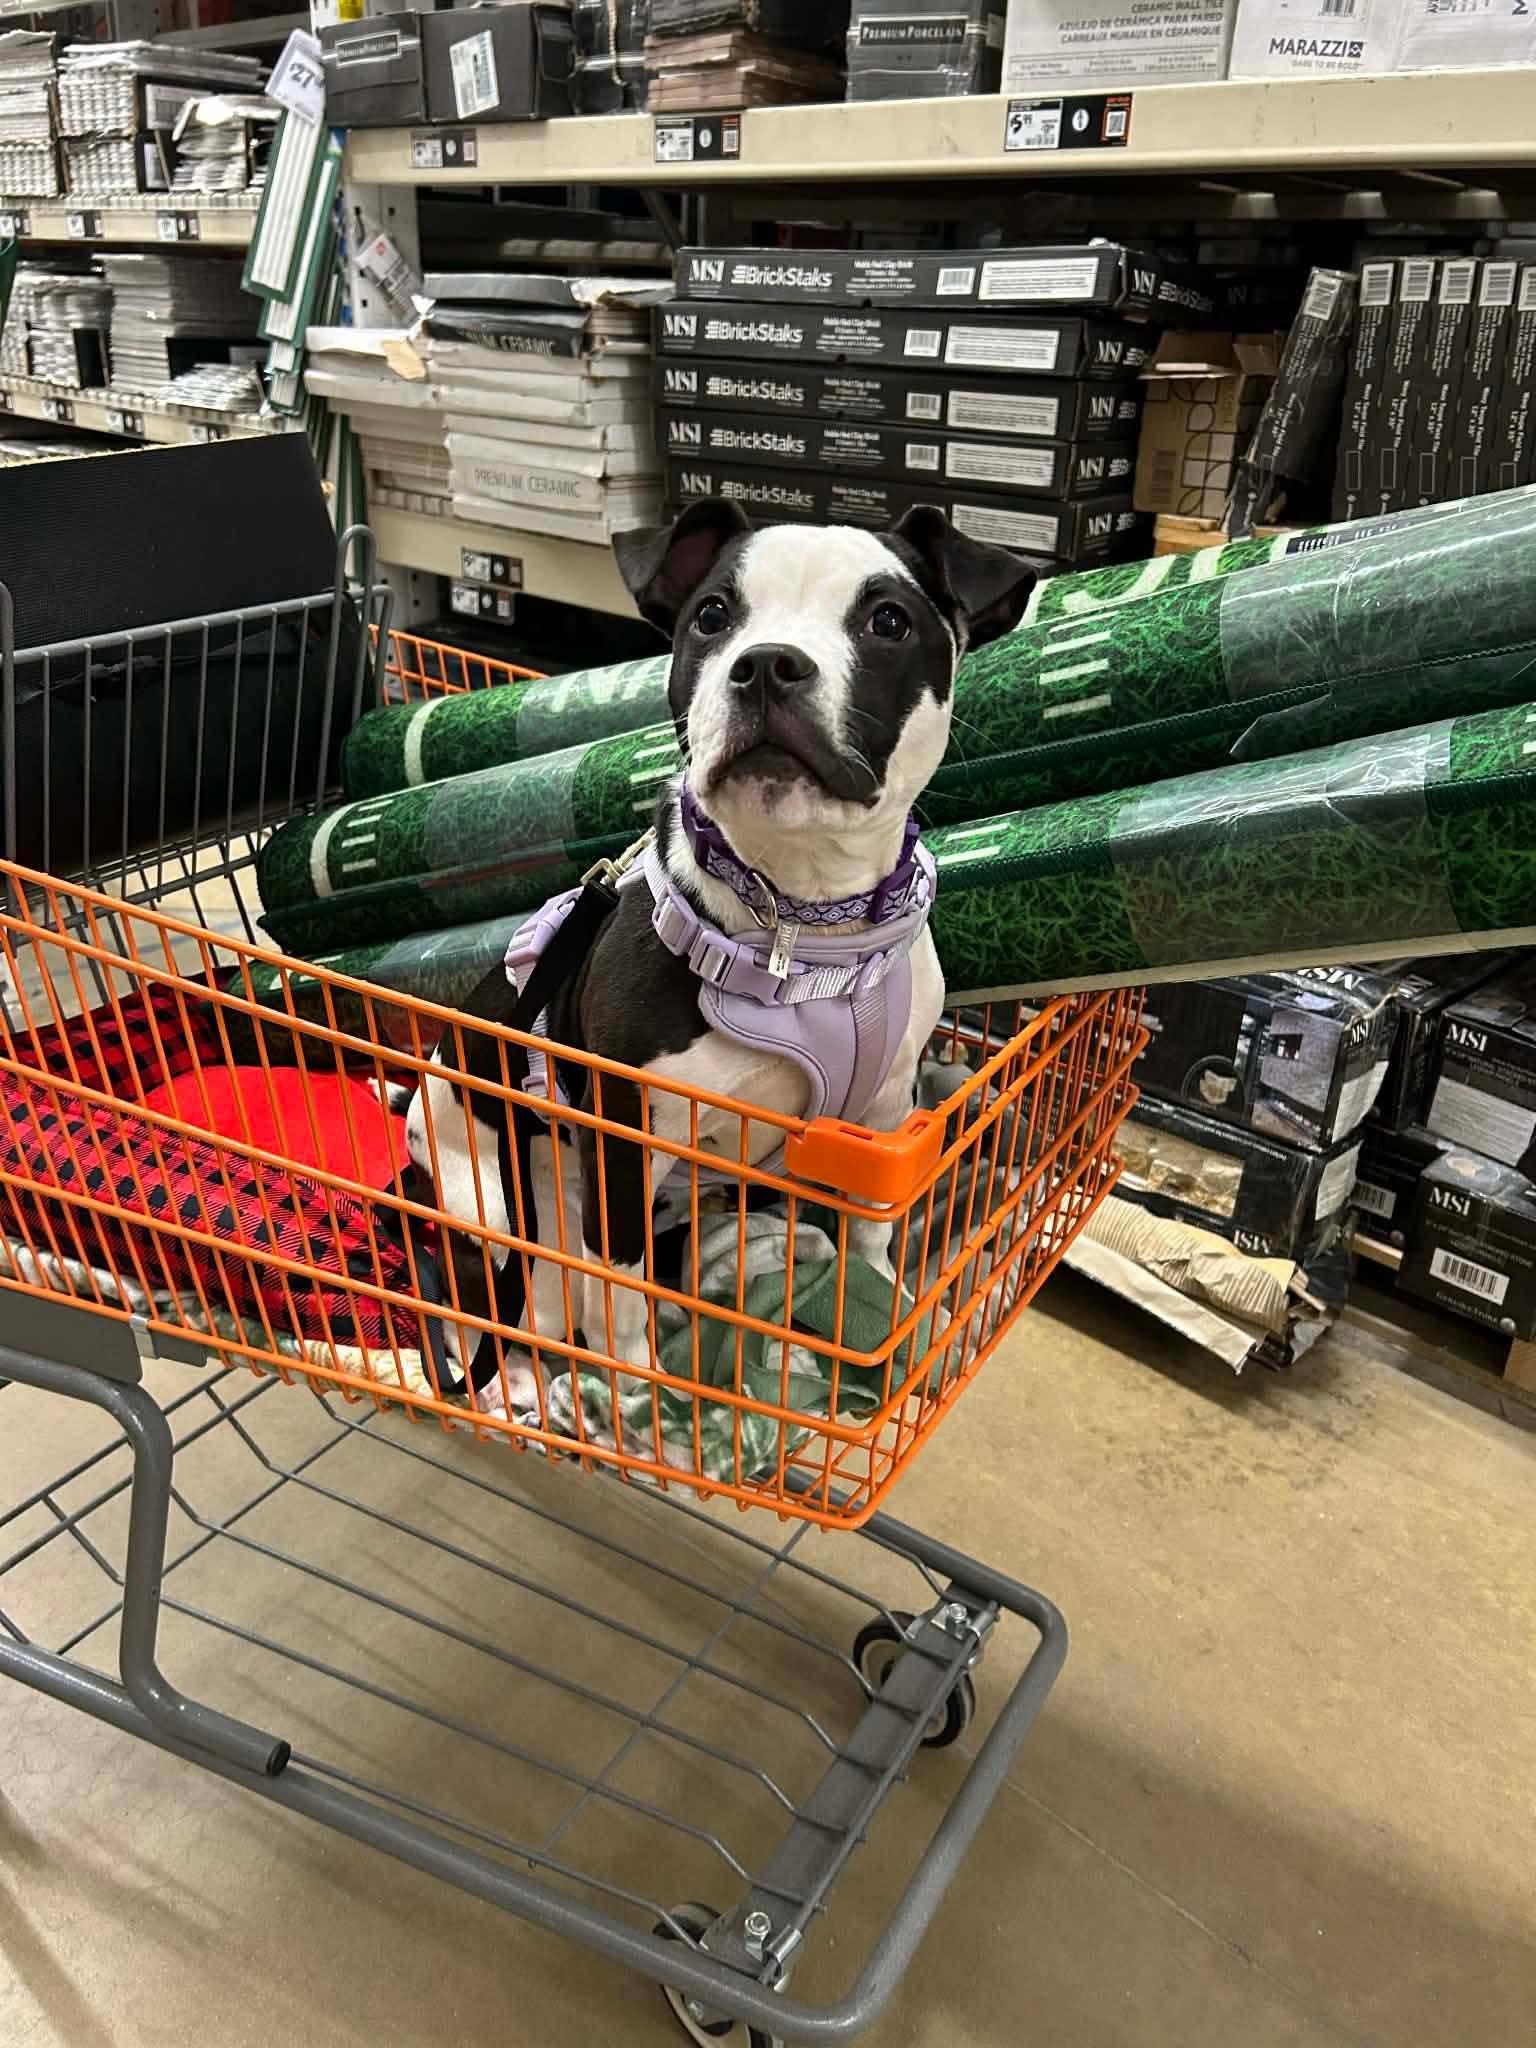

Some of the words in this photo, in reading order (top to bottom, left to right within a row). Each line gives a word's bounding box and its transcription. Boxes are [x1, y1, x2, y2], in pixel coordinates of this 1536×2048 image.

[1101, 18, 1112, 29] DE
[1163, 14, 1189, 24] PARA
[1191, 12, 1224, 23] PARED
[1061, 31, 1108, 44] CARREAUX
[1151, 28, 1162, 39] EN
[1268, 37, 1347, 58] MARAZZI
[688, 259, 725, 283] MSI
[748, 264, 833, 288] BrickStaks
[663, 314, 698, 337] MSI
[719, 321, 803, 344] BrickStaks
[664, 368, 698, 393] MSI
[720, 378, 805, 402] BrickStaks
[668, 421, 701, 444] MSI
[723, 429, 806, 453] BrickStaks
[680, 472, 713, 496] MSI
[736, 482, 815, 507] BrickStaks
[1350, 1021, 1369, 1047] MSI
[1445, 1023, 1489, 1052] MSI
[1428, 1186, 1471, 1217] MSI
